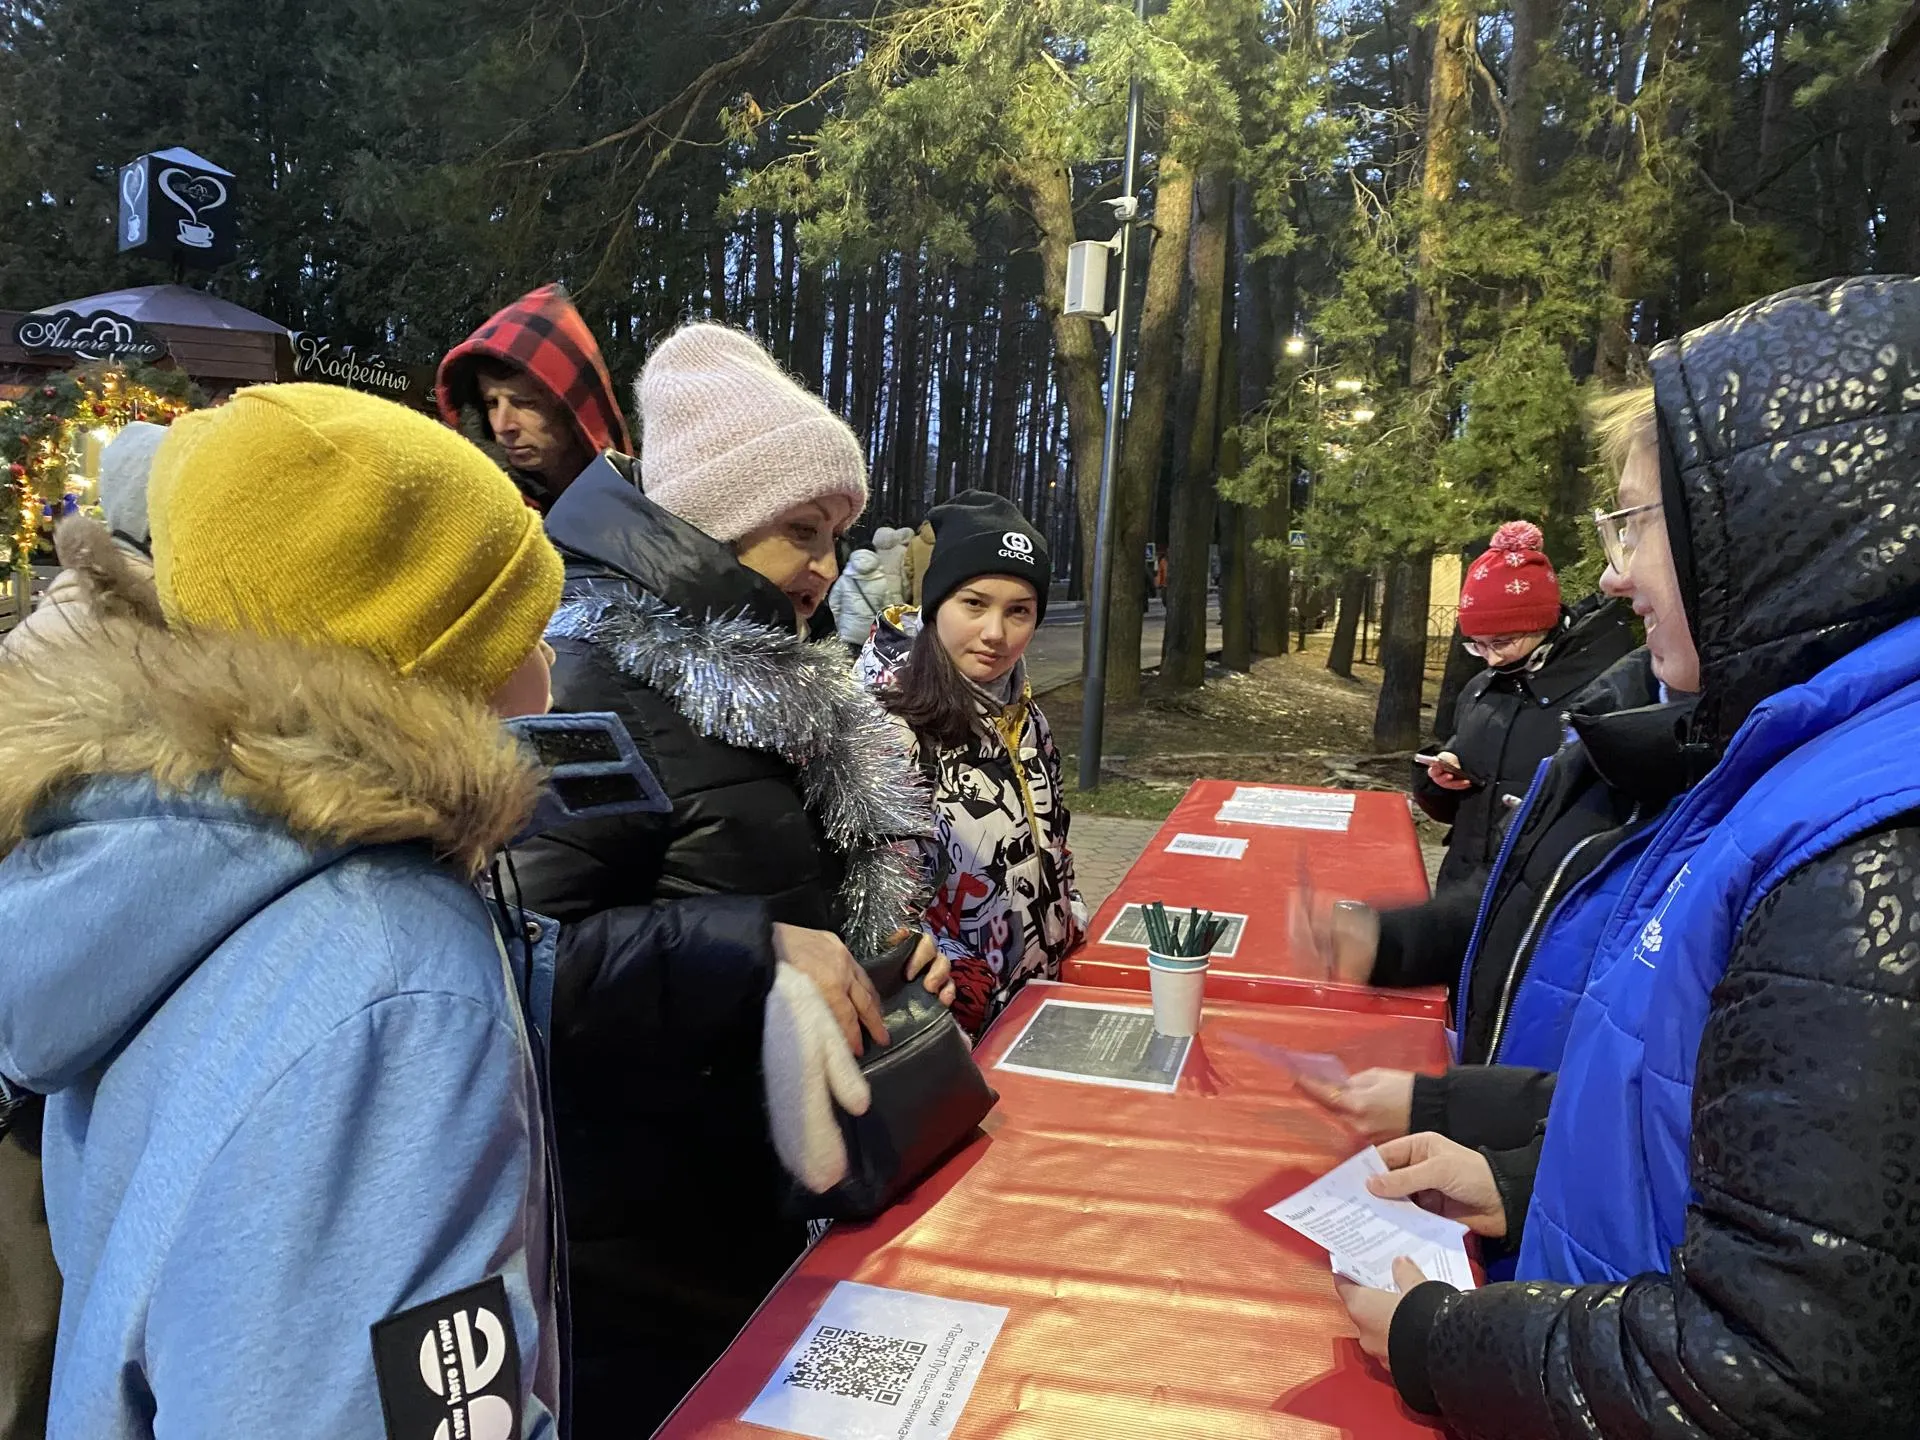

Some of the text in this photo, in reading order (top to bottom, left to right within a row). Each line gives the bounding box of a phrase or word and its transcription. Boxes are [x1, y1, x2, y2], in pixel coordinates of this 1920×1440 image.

[19, 317, 156, 354] Amore mio
[300, 338, 410, 391] Кофейня
[998, 549, 1035, 565] GUCCI
[945, 1341, 980, 1392] Регистрация
[928, 1399, 949, 1427] акции
